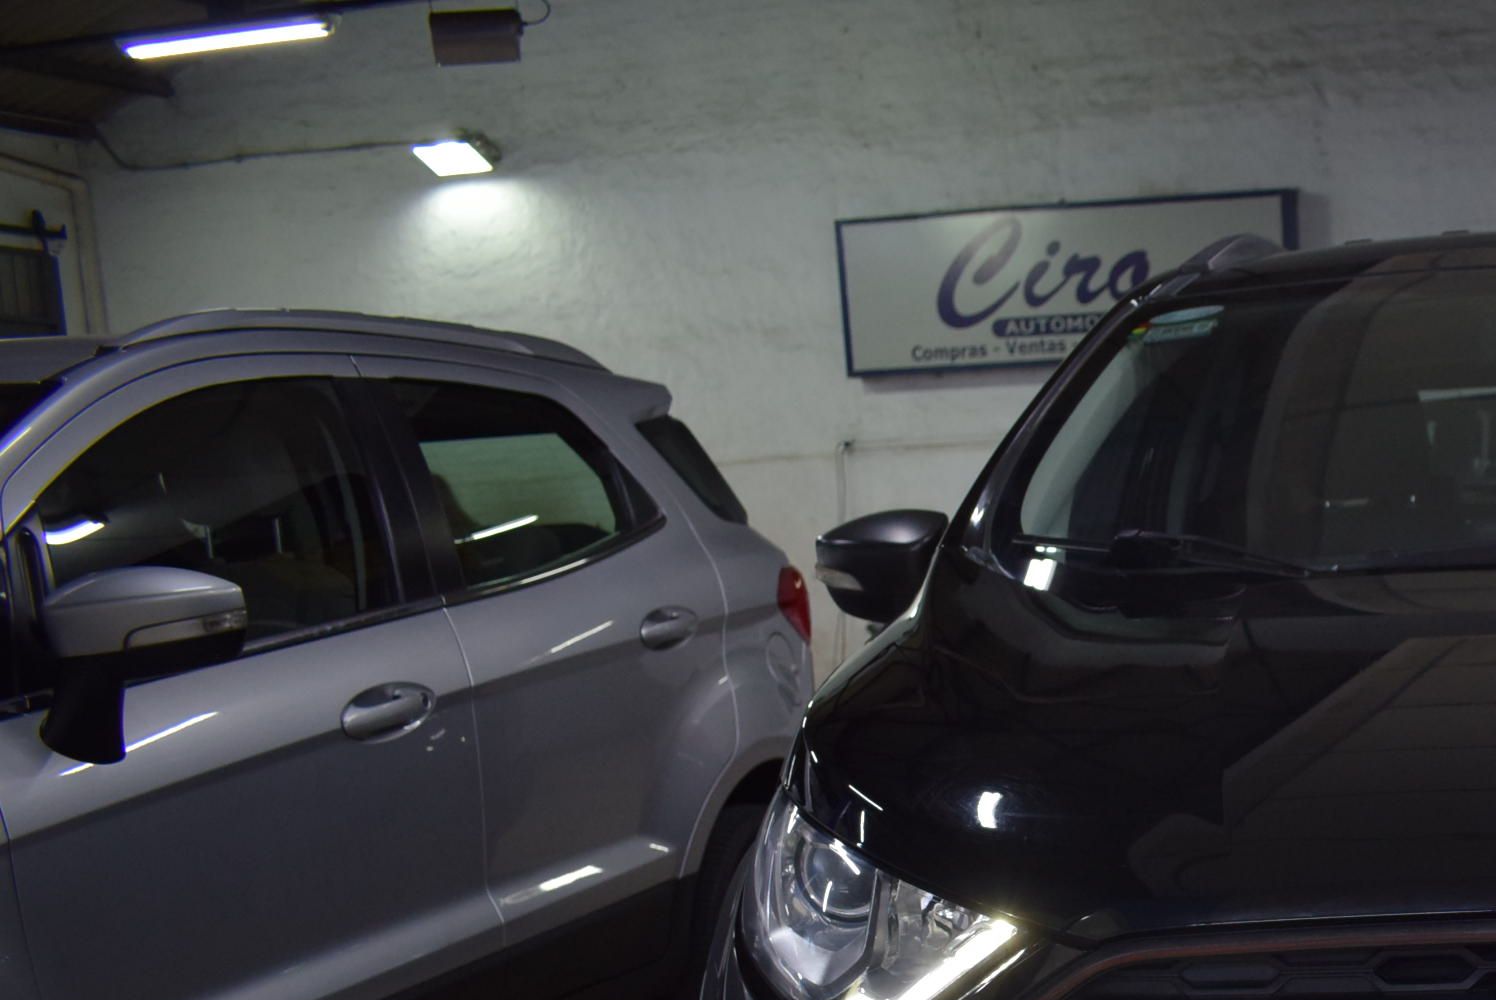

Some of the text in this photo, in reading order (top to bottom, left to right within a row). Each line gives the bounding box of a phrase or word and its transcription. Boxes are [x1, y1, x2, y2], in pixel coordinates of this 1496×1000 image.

[936, 216, 1151, 329] Ciro
[911, 344, 987, 361] Compras
[1005, 338, 1066, 355] Ventas
